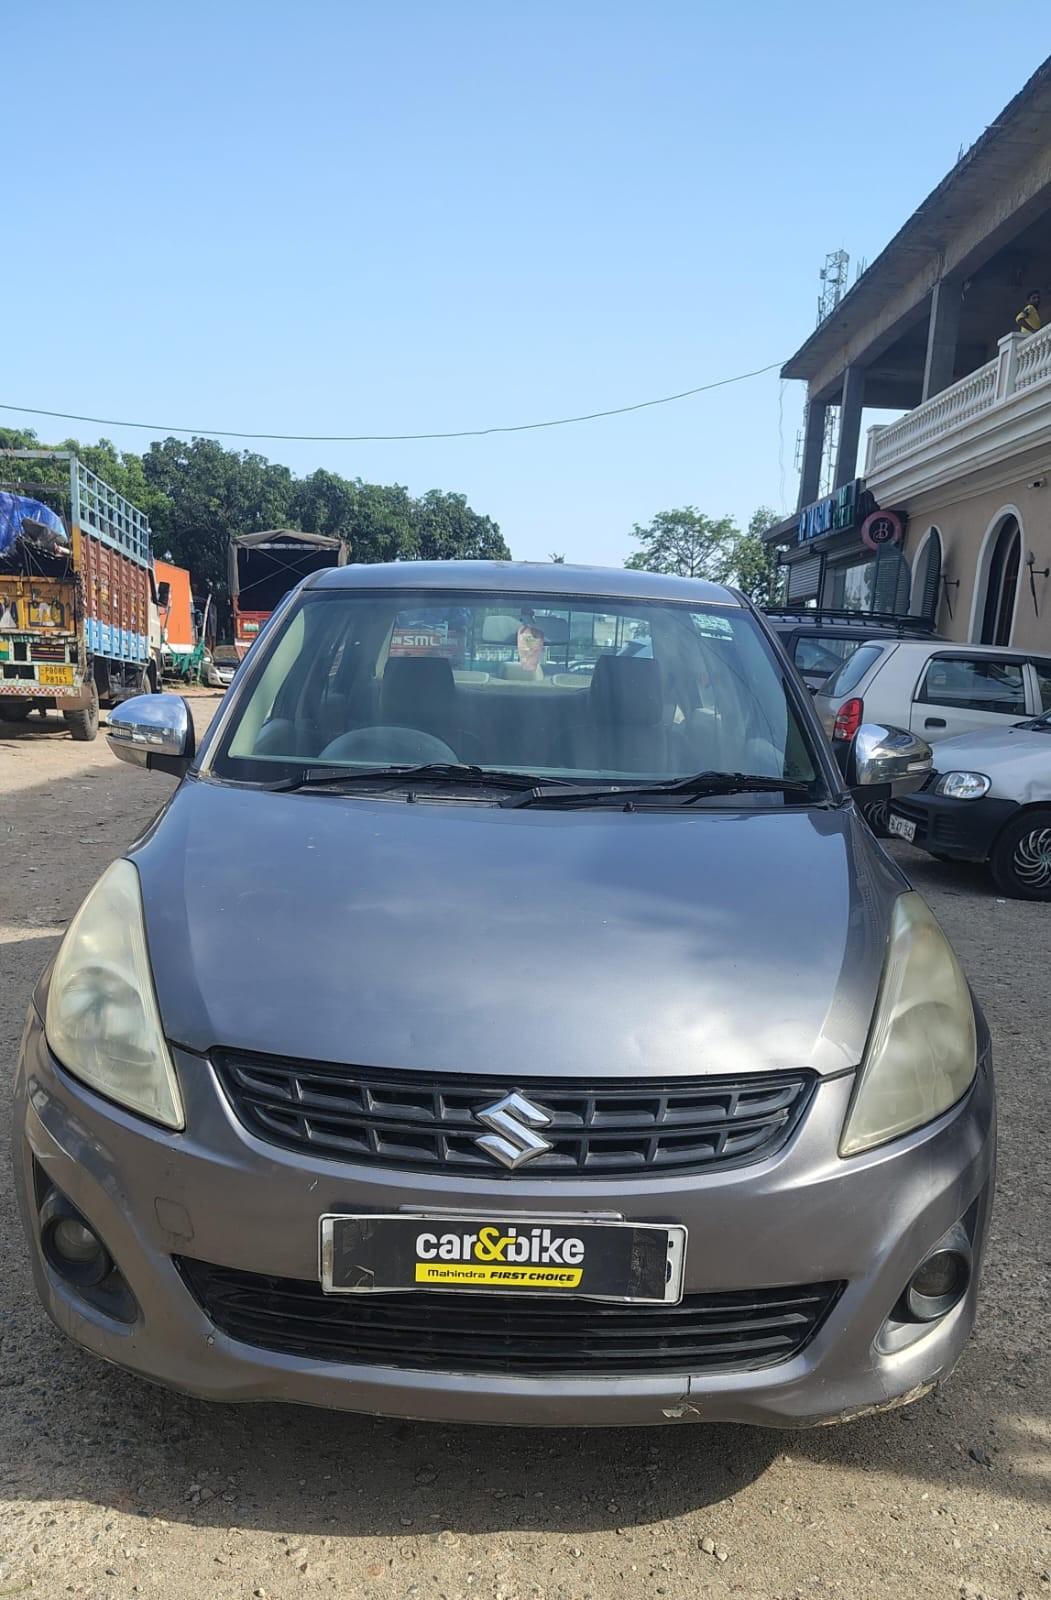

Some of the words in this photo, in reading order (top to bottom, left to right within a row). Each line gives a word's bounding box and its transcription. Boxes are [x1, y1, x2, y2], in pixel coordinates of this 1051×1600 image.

[427, 1269, 486, 1279] Mahindra
[490, 1271, 528, 1280] FIRST
[528, 1273, 576, 1282] CHOICE
